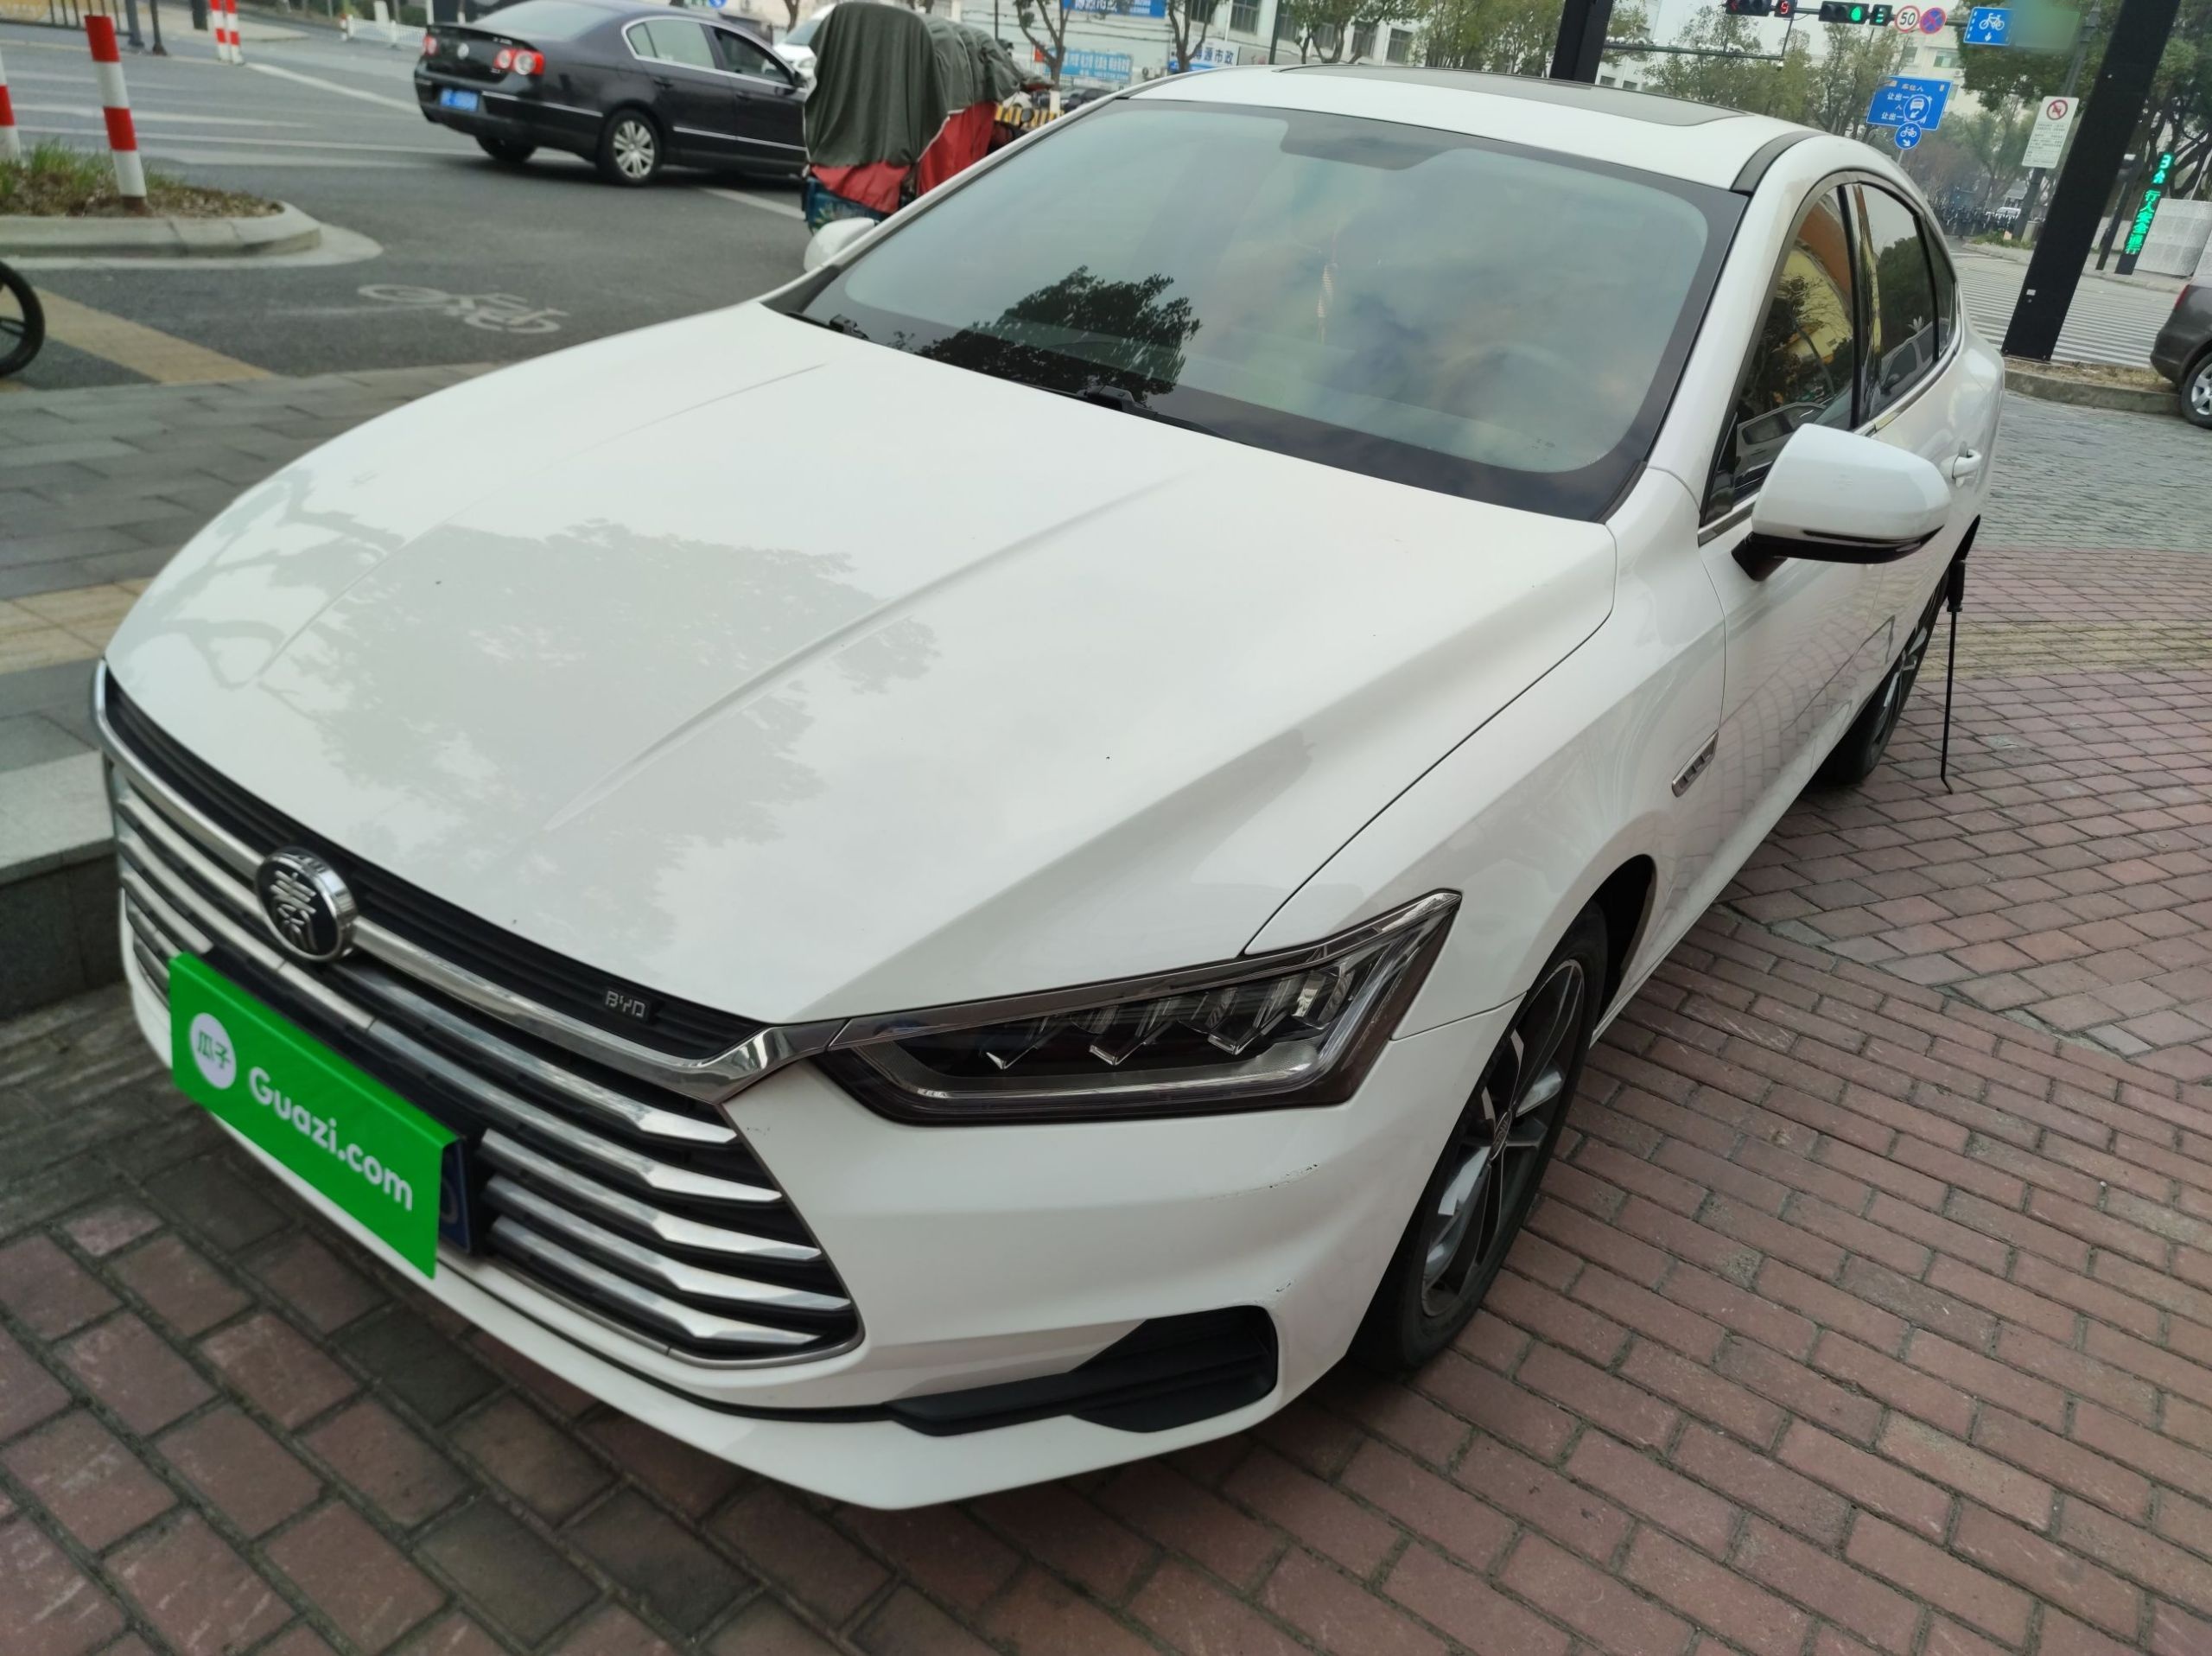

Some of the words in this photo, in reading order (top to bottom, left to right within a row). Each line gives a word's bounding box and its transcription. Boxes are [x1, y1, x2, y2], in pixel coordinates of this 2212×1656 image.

[1899, 11, 1916, 26] 50
[606, 990, 645, 1018] BYD
[198, 1030, 232, 1069] 瓜子
[249, 1067, 413, 1212] Guazi.com
